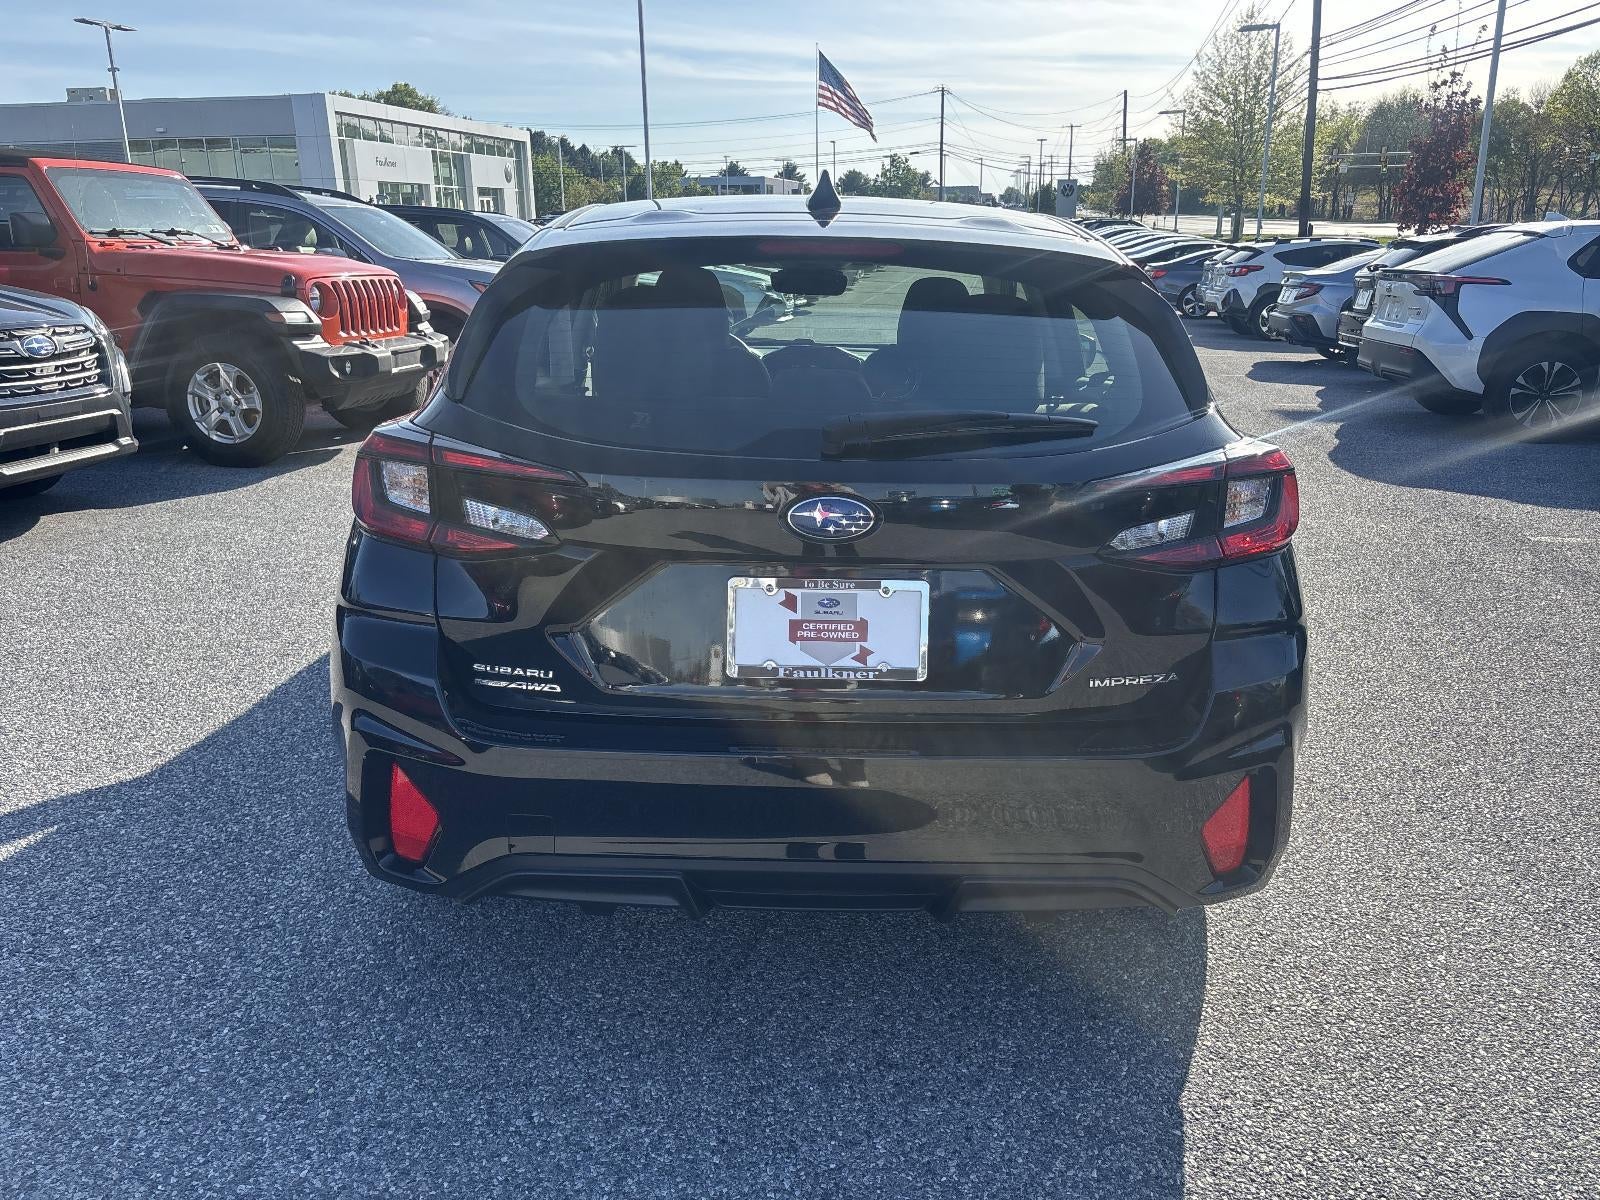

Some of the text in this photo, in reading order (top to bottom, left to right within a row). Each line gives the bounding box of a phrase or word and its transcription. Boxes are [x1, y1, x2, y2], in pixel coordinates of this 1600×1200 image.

[804, 580, 856, 589] To Be Sure
[802, 622, 854, 631] CERTIFIED
[797, 631, 859, 639] PRE-OWNED
[473, 663, 553, 678] SUBARU
[778, 667, 879, 679] Faulkner
[1089, 672, 1178, 688] IMPREZA
